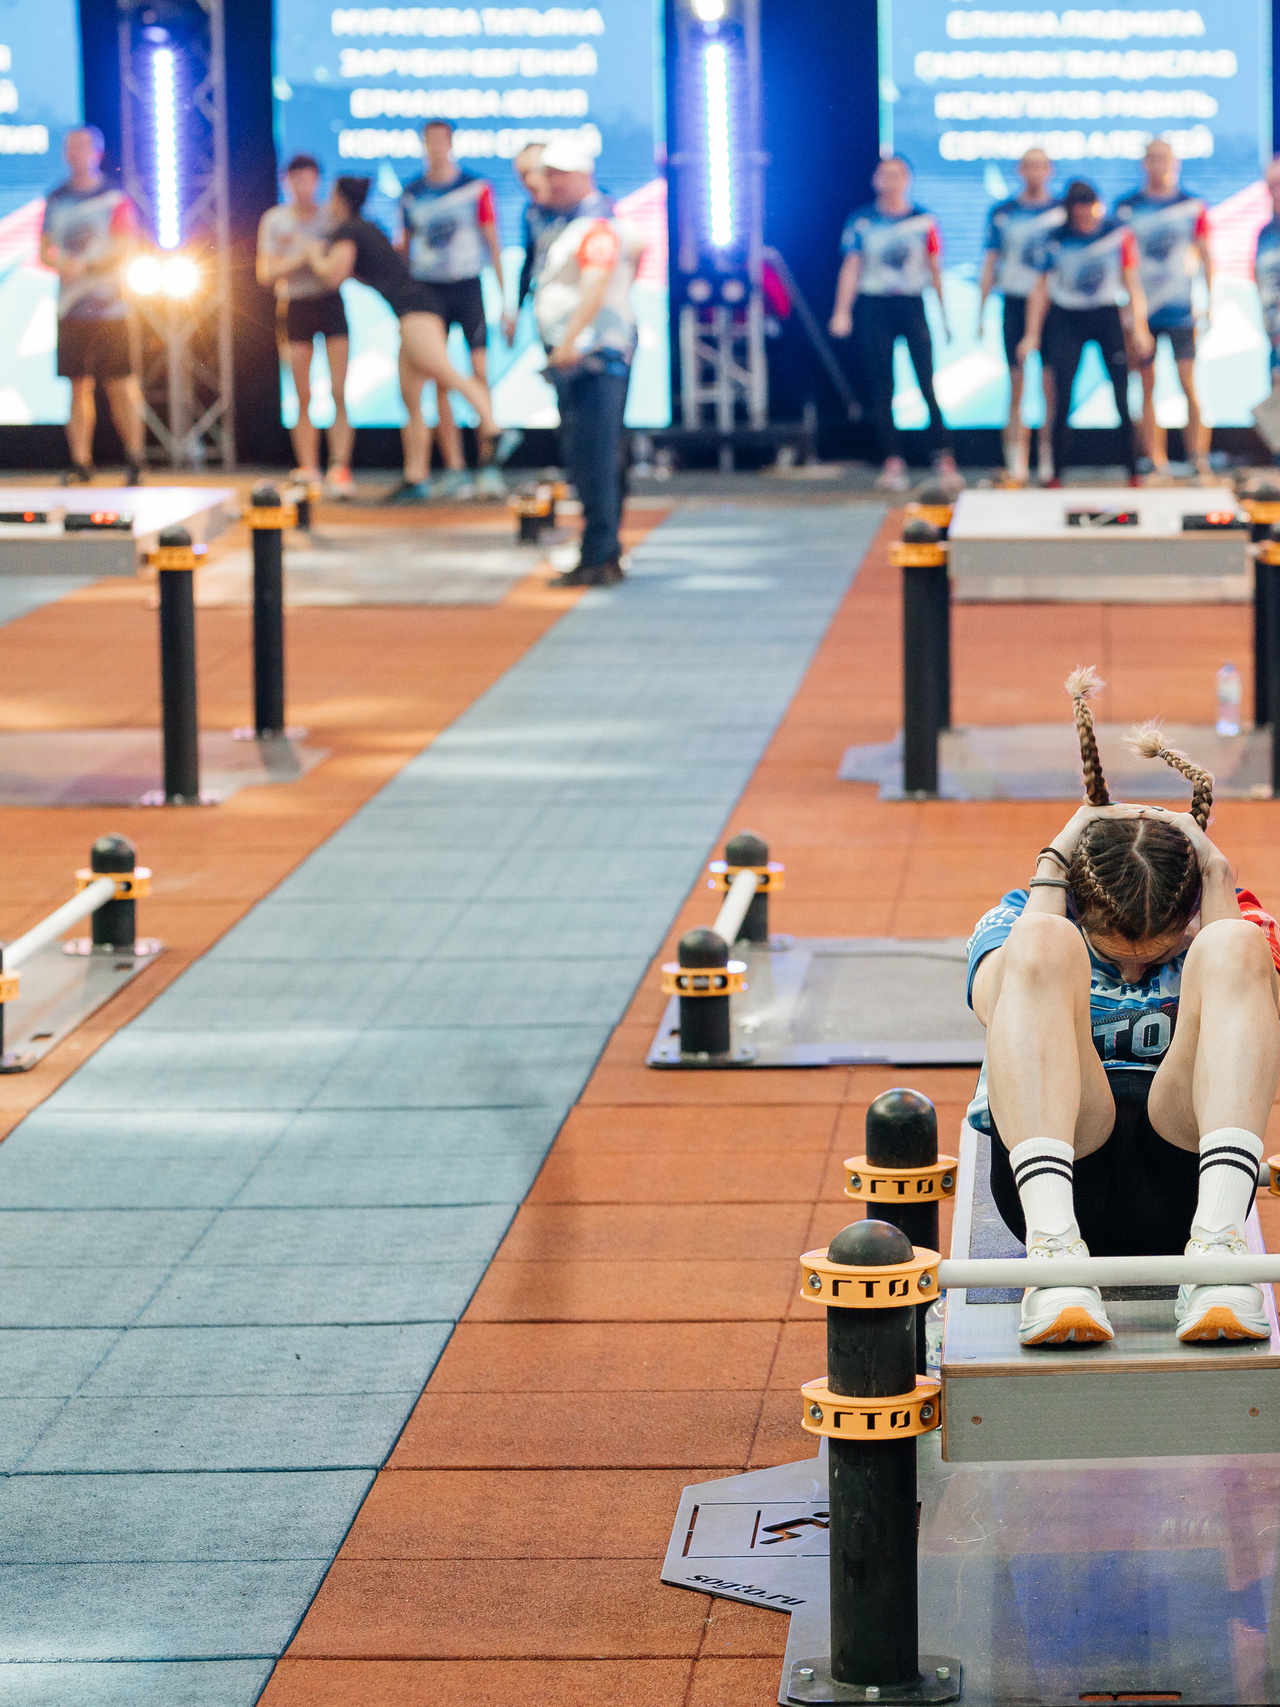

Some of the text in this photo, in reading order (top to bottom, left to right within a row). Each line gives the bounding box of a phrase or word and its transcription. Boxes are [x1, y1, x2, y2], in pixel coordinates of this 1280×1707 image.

[1093, 1012, 1171, 1059] ТО
[870, 1179, 933, 1195] ГТО
[832, 1279, 909, 1298] ГТО
[834, 1410, 911, 1430] ГТО
[686, 1574, 808, 1605] sogto.ru
